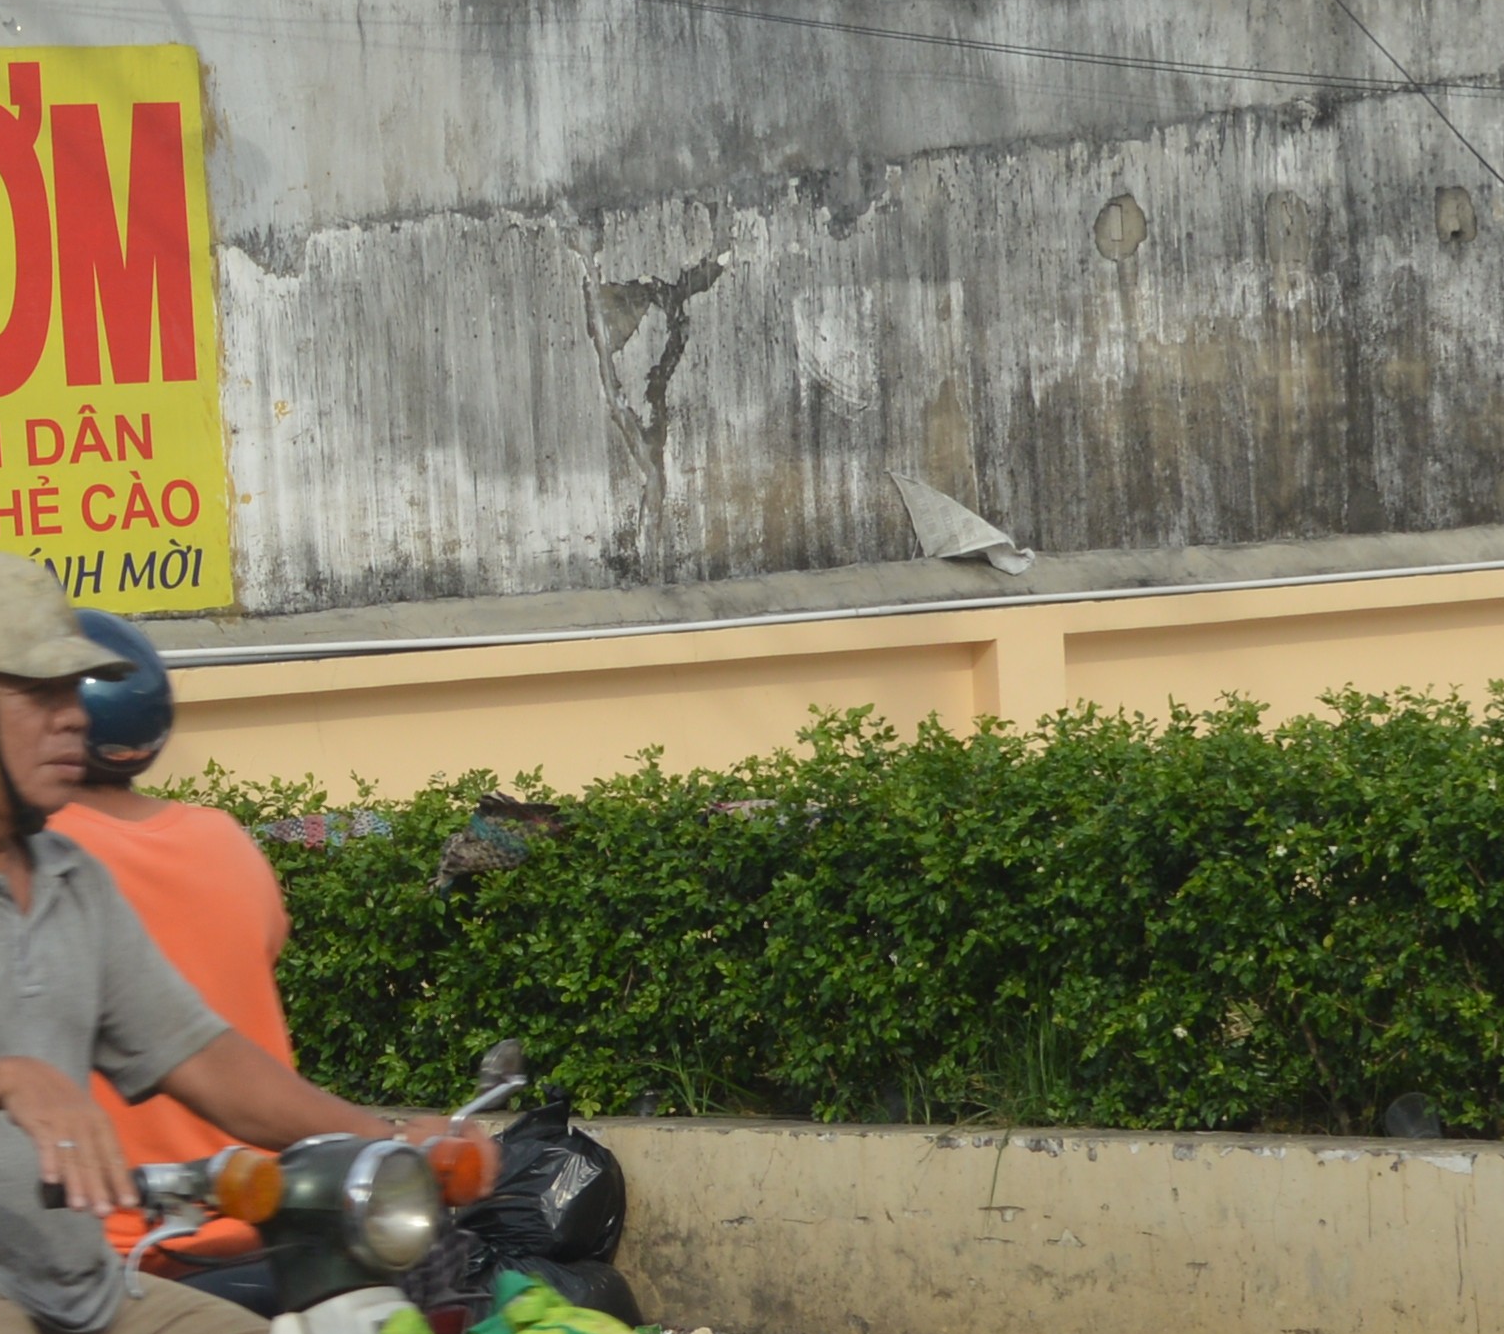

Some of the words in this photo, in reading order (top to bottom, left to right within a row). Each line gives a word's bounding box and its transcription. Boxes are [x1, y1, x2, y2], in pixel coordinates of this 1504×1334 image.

[25, 404, 154, 465] DÂN
[80, 471, 201, 533] CÀO
[118, 539, 204, 592] MỜI
